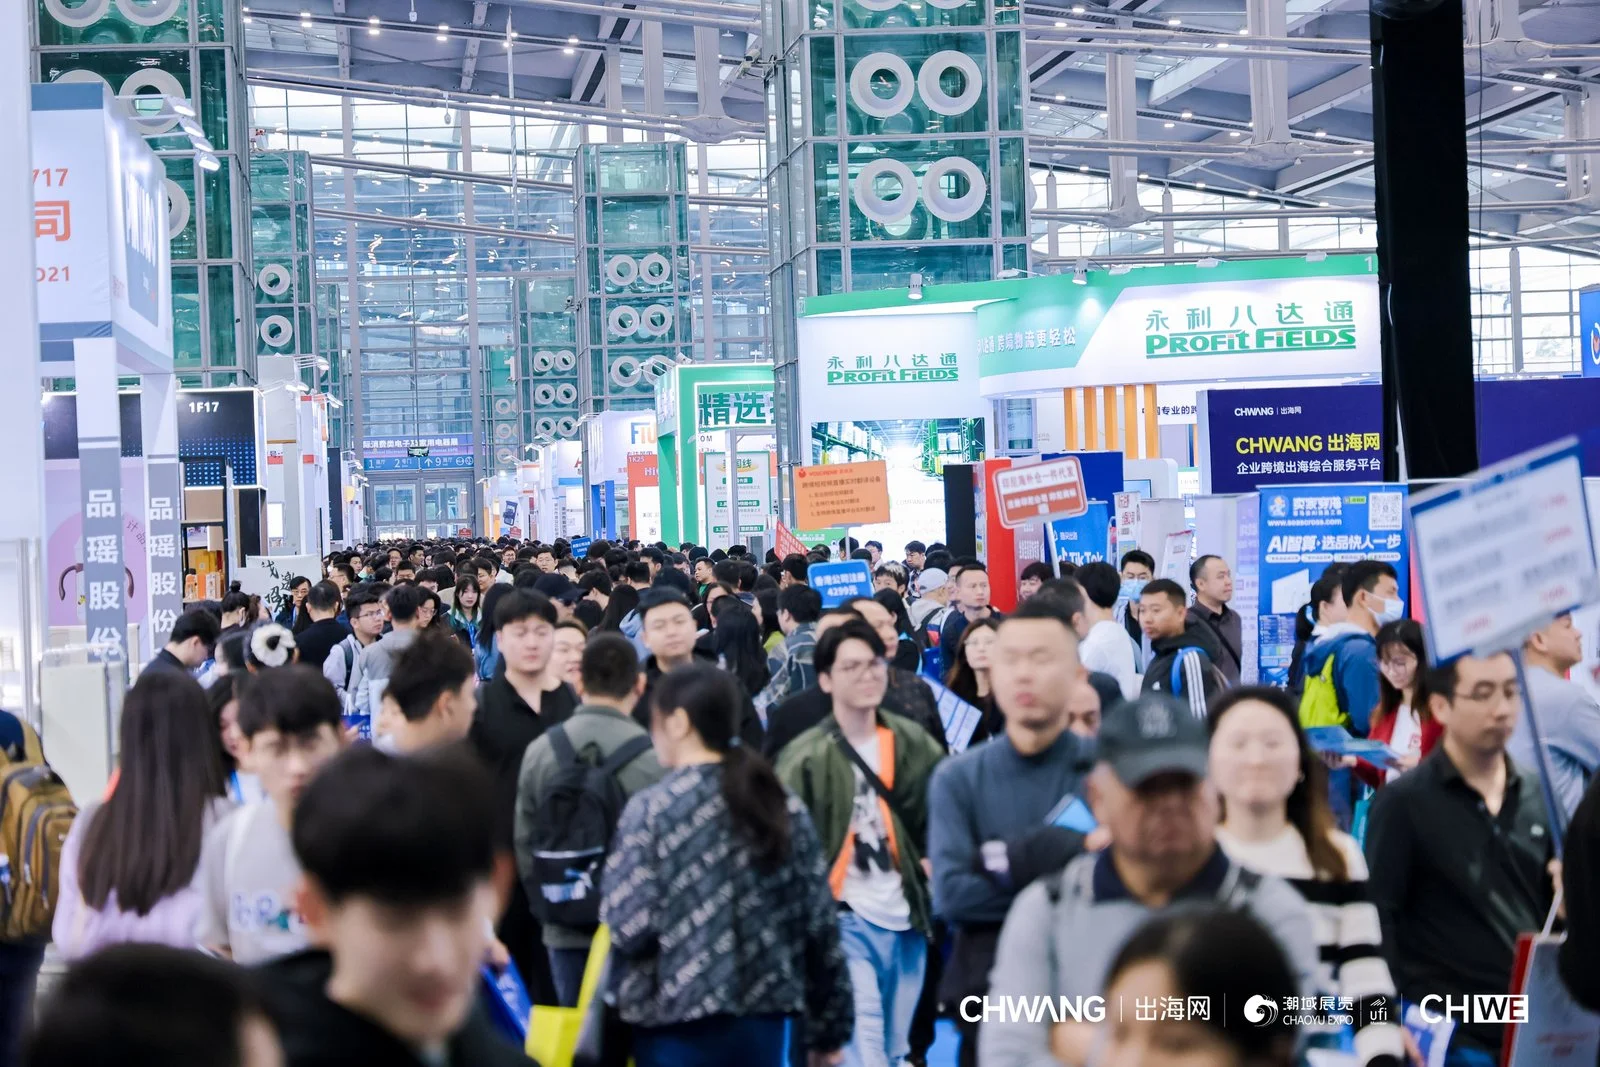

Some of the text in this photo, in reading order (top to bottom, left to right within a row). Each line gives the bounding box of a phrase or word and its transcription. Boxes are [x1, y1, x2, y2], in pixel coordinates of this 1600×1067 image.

[1146, 301, 1353, 330] 永利八达通
[827, 352, 957, 369] 永利八达通
[189, 402, 219, 413] 1F17
[1234, 406, 1302, 416] CHWANG 出海网
[1236, 432, 1381, 454] CHWANG 出海网
[1236, 457, 1382, 475] 企业跨境出海综合服务平台
